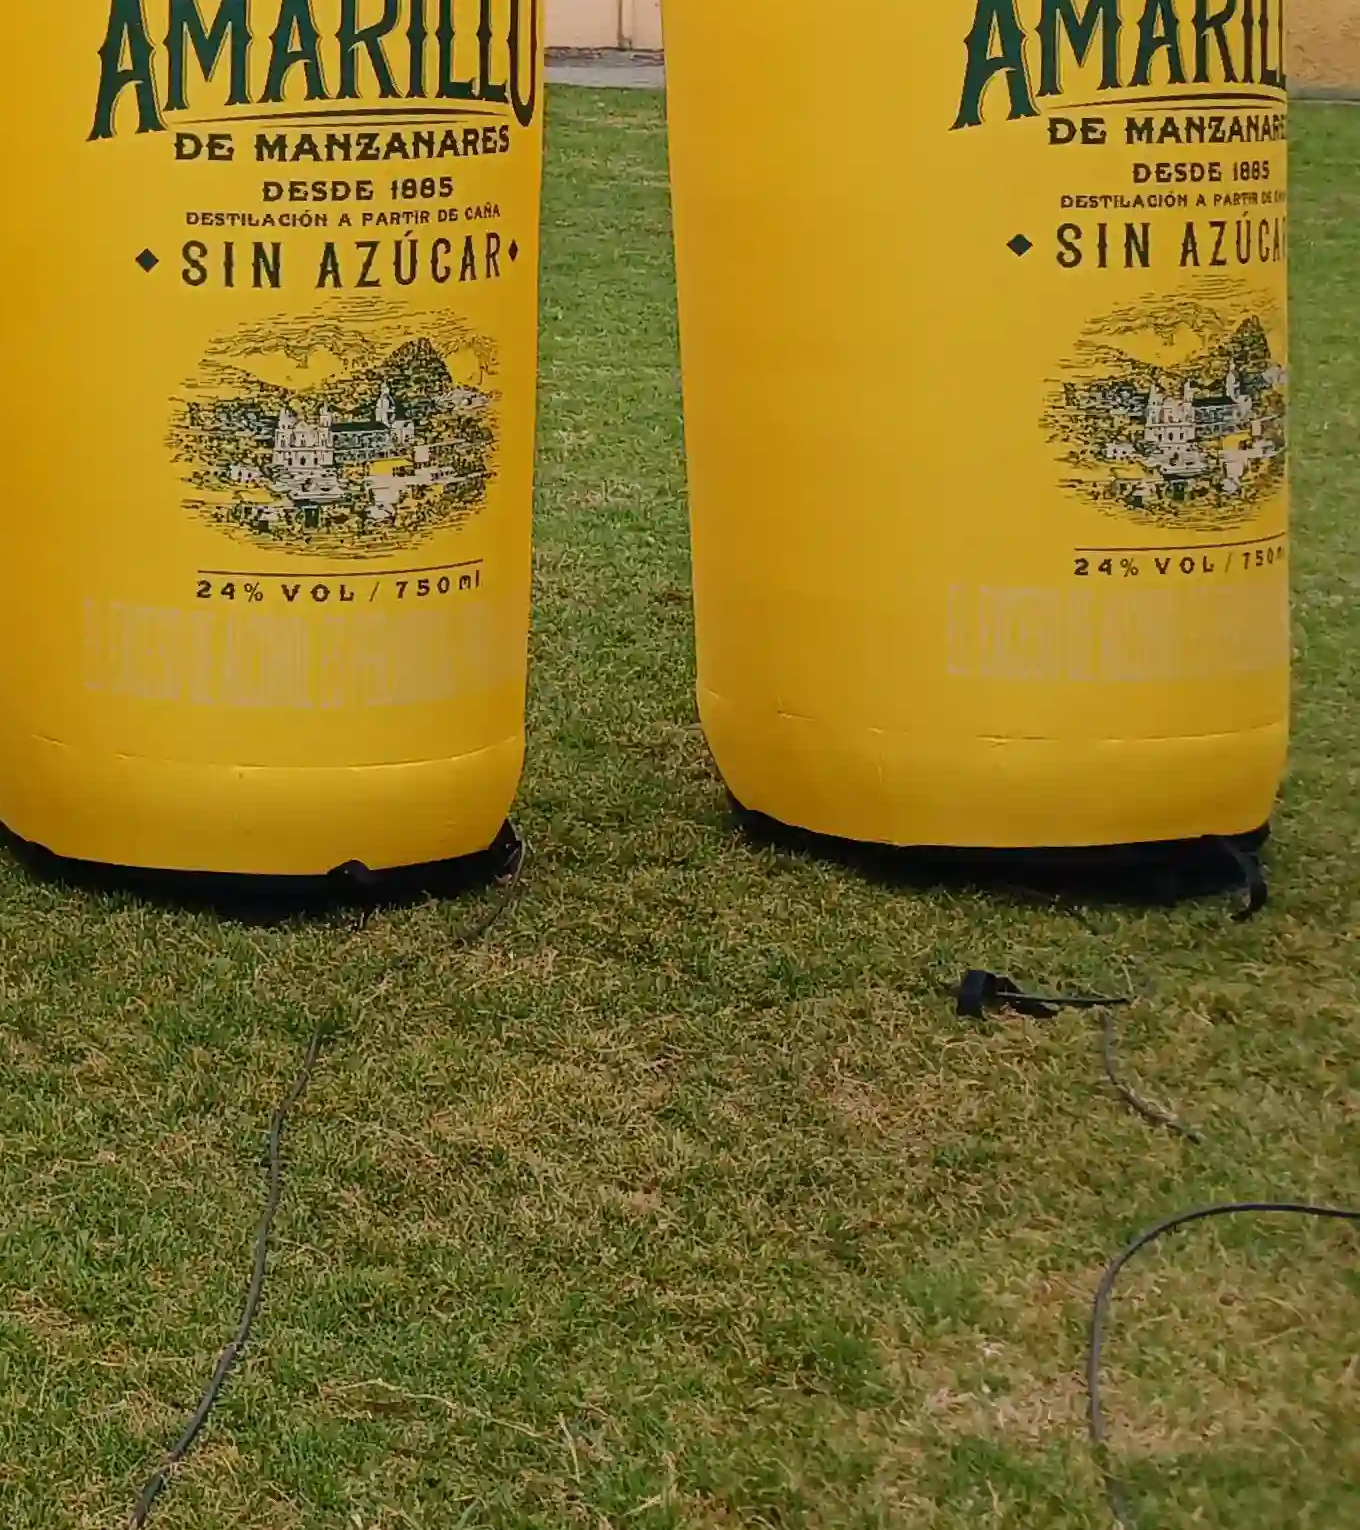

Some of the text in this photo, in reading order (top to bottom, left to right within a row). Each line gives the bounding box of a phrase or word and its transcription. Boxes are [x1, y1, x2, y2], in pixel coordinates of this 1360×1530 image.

[174, 124, 511, 163] DE MANZANARES
[1047, 117, 1108, 146] DE
[1132, 160, 1271, 184] DESDE 1885
[261, 176, 455, 204] DESDE 1885
[1060, 189, 1188, 210] DESTILACIÓN
[1196, 194, 1207, 209] A
[185, 202, 502, 229] DESTILACIÓN A PARTIR DE CAÑA
[1055, 221, 1152, 269] SIN
[180, 230, 503, 290] SIN AZÚCAR
[1073, 556, 1140, 579] 24%
[1153, 556, 1215, 576] VOL
[195, 579, 265, 604] 24%
[279, 583, 355, 604] VOL
